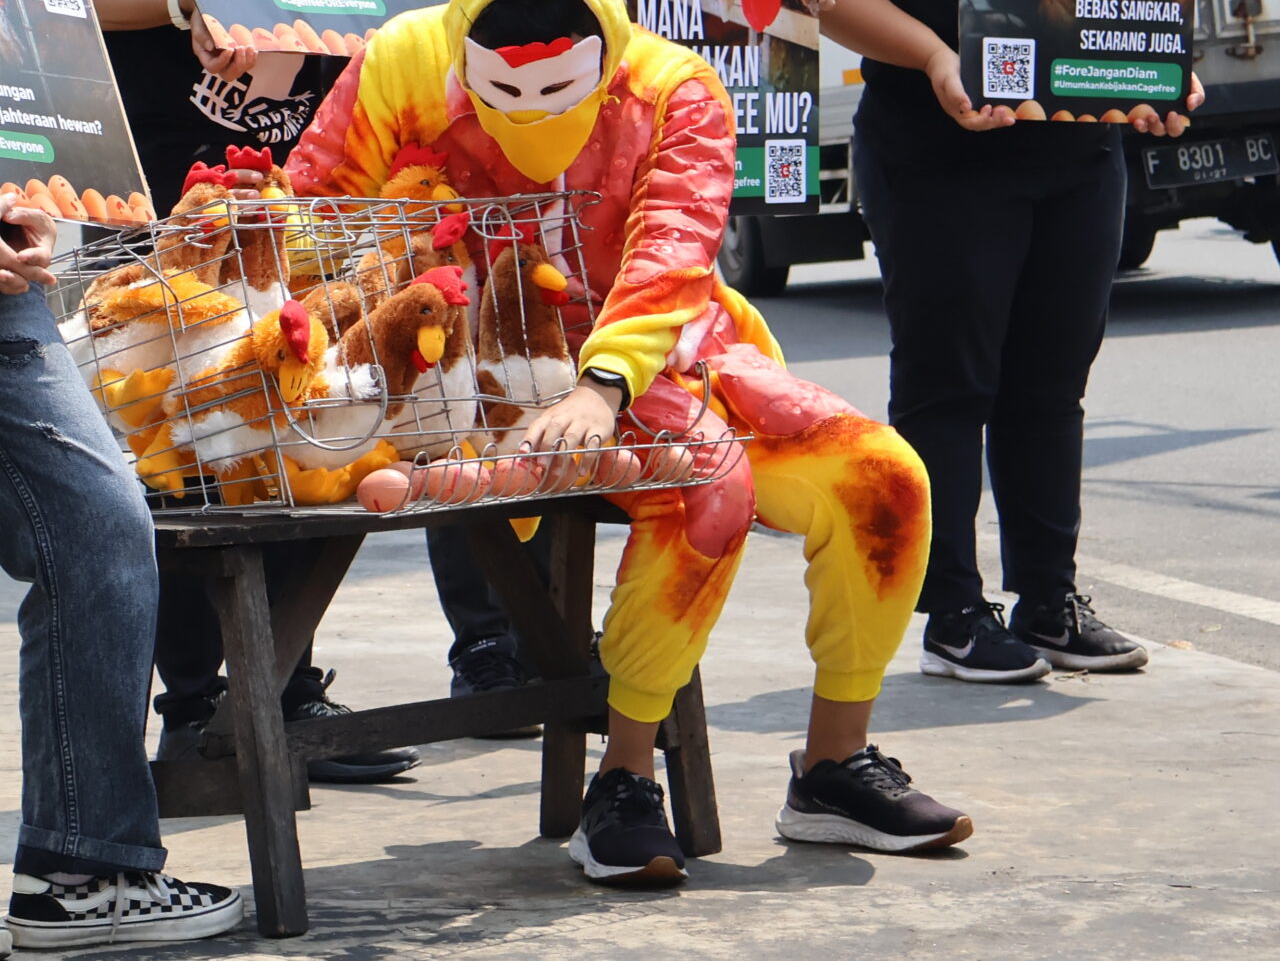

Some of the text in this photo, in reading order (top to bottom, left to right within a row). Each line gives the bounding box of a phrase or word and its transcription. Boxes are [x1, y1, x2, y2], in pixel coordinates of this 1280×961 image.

[1120, 0, 1183, 25] SANGKAR,
[1080, 29, 1186, 54] SEKARANG JUGA.
[1055, 65, 1158, 80] #ForeJanganDiam
[1054, 80, 1176, 93] #UmumkanKebijakanCagefree
[58, 113, 103, 136] hewan?
[765, 91, 813, 134] MU?
[1146, 139, 1271, 174] F 8301 BC
